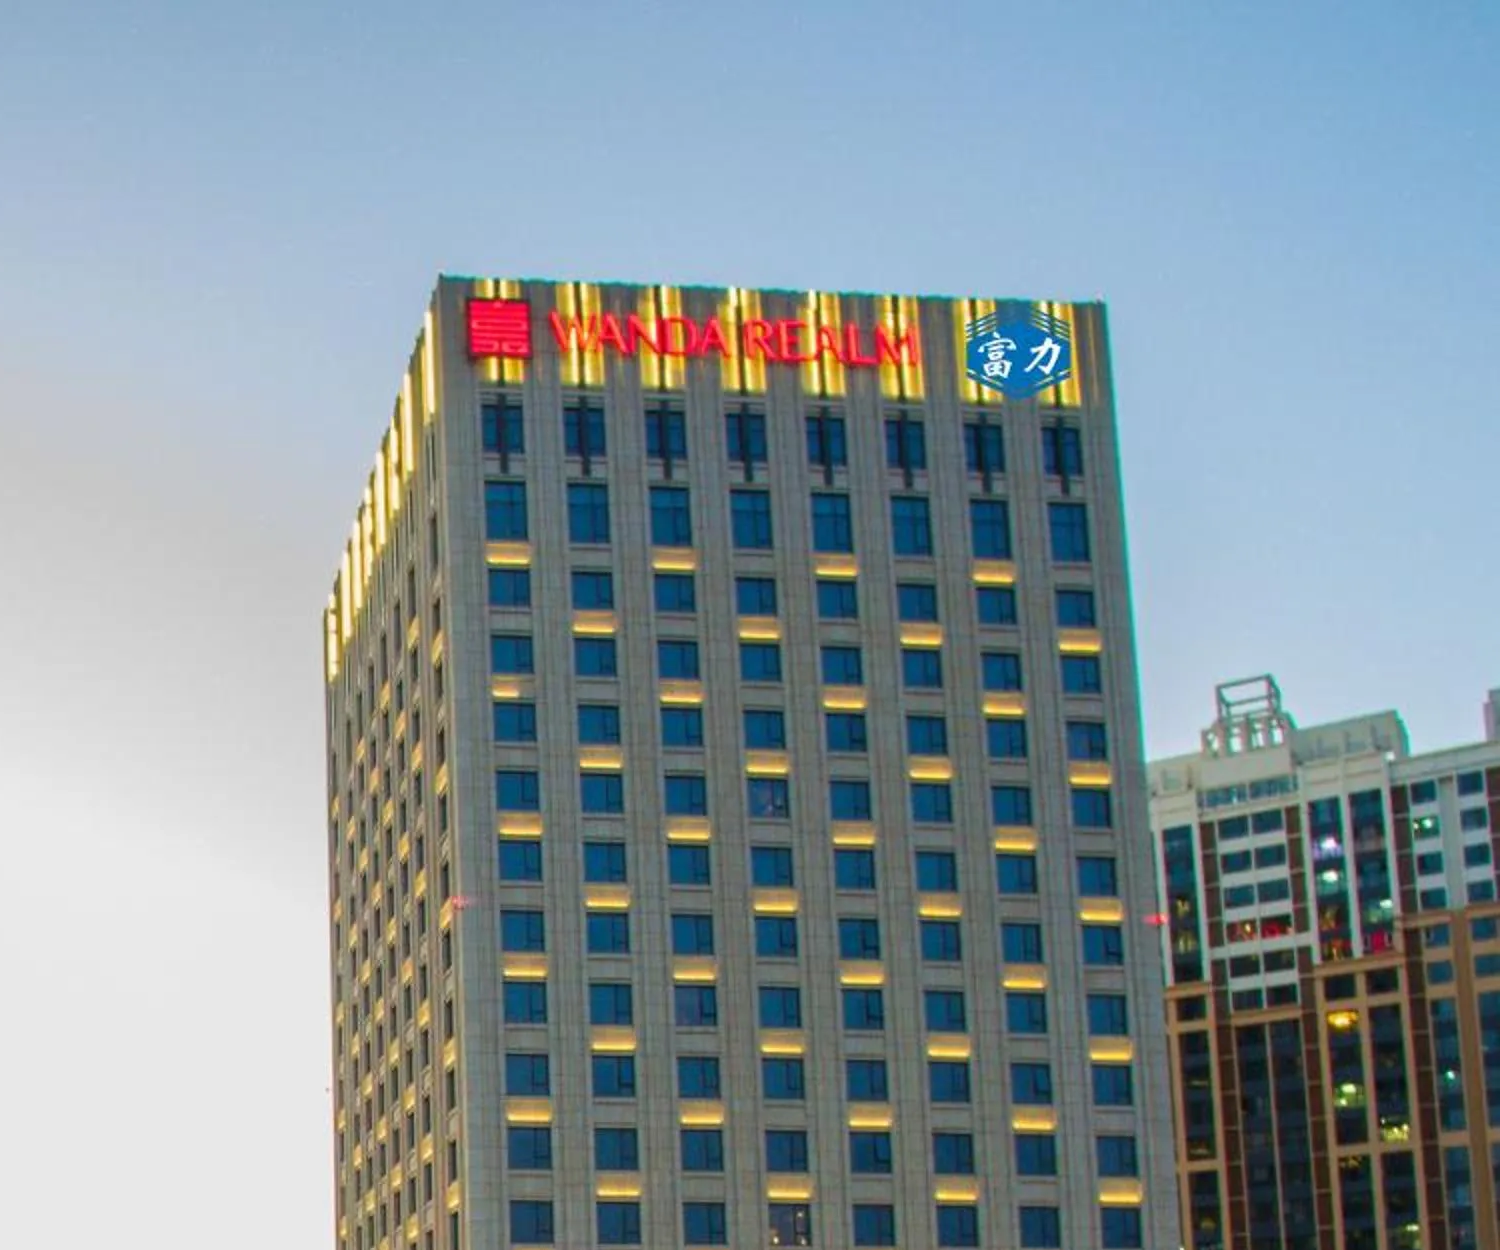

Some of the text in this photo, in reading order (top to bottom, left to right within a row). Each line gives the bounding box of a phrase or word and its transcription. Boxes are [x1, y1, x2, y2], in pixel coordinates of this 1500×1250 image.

[549, 310, 920, 368] WANDA REALM
[977, 331, 1061, 379] 富力
